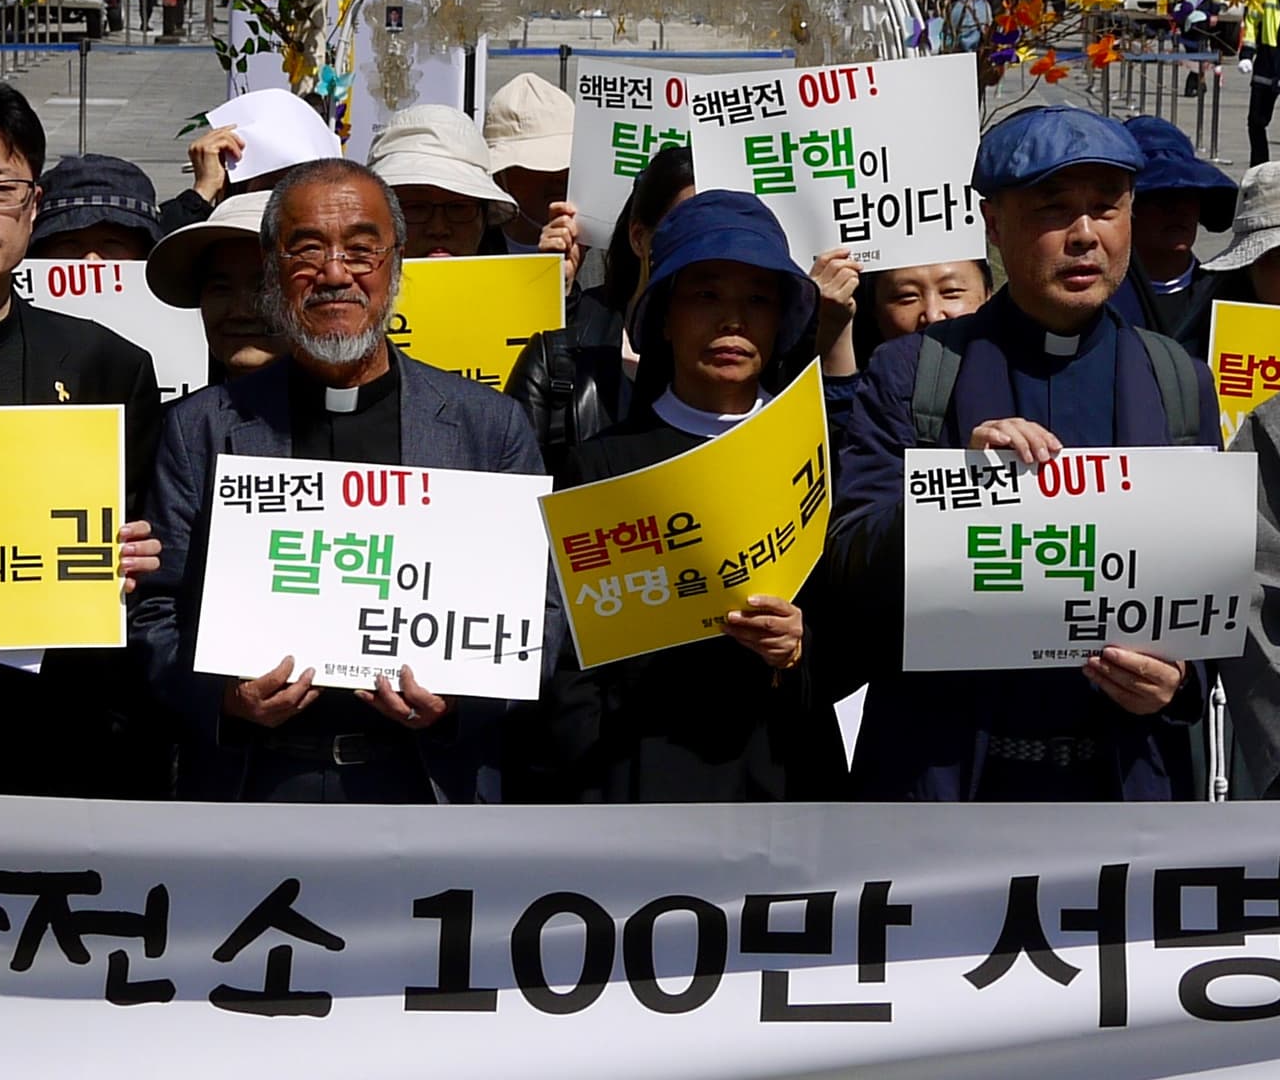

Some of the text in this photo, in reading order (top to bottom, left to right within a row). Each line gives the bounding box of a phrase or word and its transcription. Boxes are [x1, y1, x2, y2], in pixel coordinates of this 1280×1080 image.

[579, 75, 653, 110] 핵발전
[692, 79, 788, 126] 핵발전
[798, 66, 878, 108] OUT!
[744, 126, 889, 195] 탈핵이
[833, 183, 976, 243] 답이다!
[48, 264, 123, 297] OUT!
[219, 469, 432, 514] 핵발전 OUT!
[910, 454, 1131, 511] 핵발전 OUT!
[50, 507, 114, 581] 길
[562, 511, 703, 573] 탈핵은
[575, 443, 827, 617] 생명을 살리는 길
[967, 523, 1136, 592] 탈핵이
[268, 529, 432, 601] 탈핵이
[358, 606, 531, 664] 답이다!
[1064, 594, 1239, 642] 답이다!
[404, 879, 913, 1026] 100만
